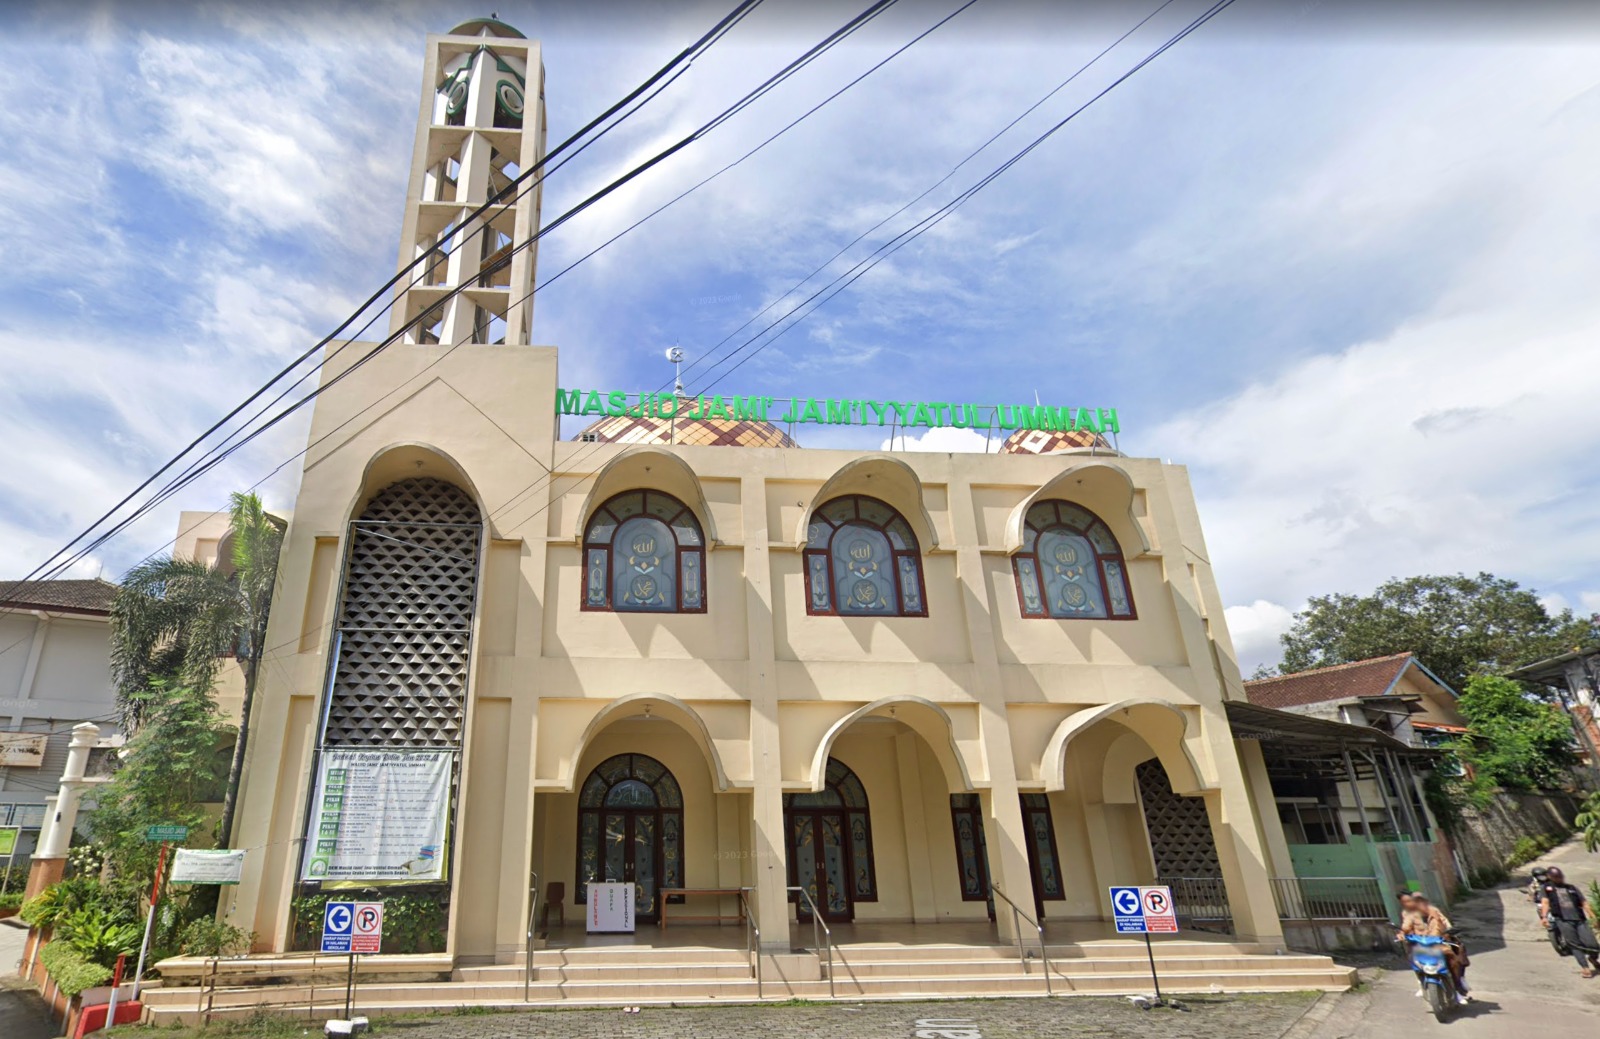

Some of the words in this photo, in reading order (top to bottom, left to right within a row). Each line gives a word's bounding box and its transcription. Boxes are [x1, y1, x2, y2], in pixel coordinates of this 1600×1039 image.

[556, 388, 679, 418] MASJID
[689, 393, 773, 422] JAMI'
[782, 397, 991, 428] JAM'IYYATUL
[996, 403, 1121, 433] UMMAH
